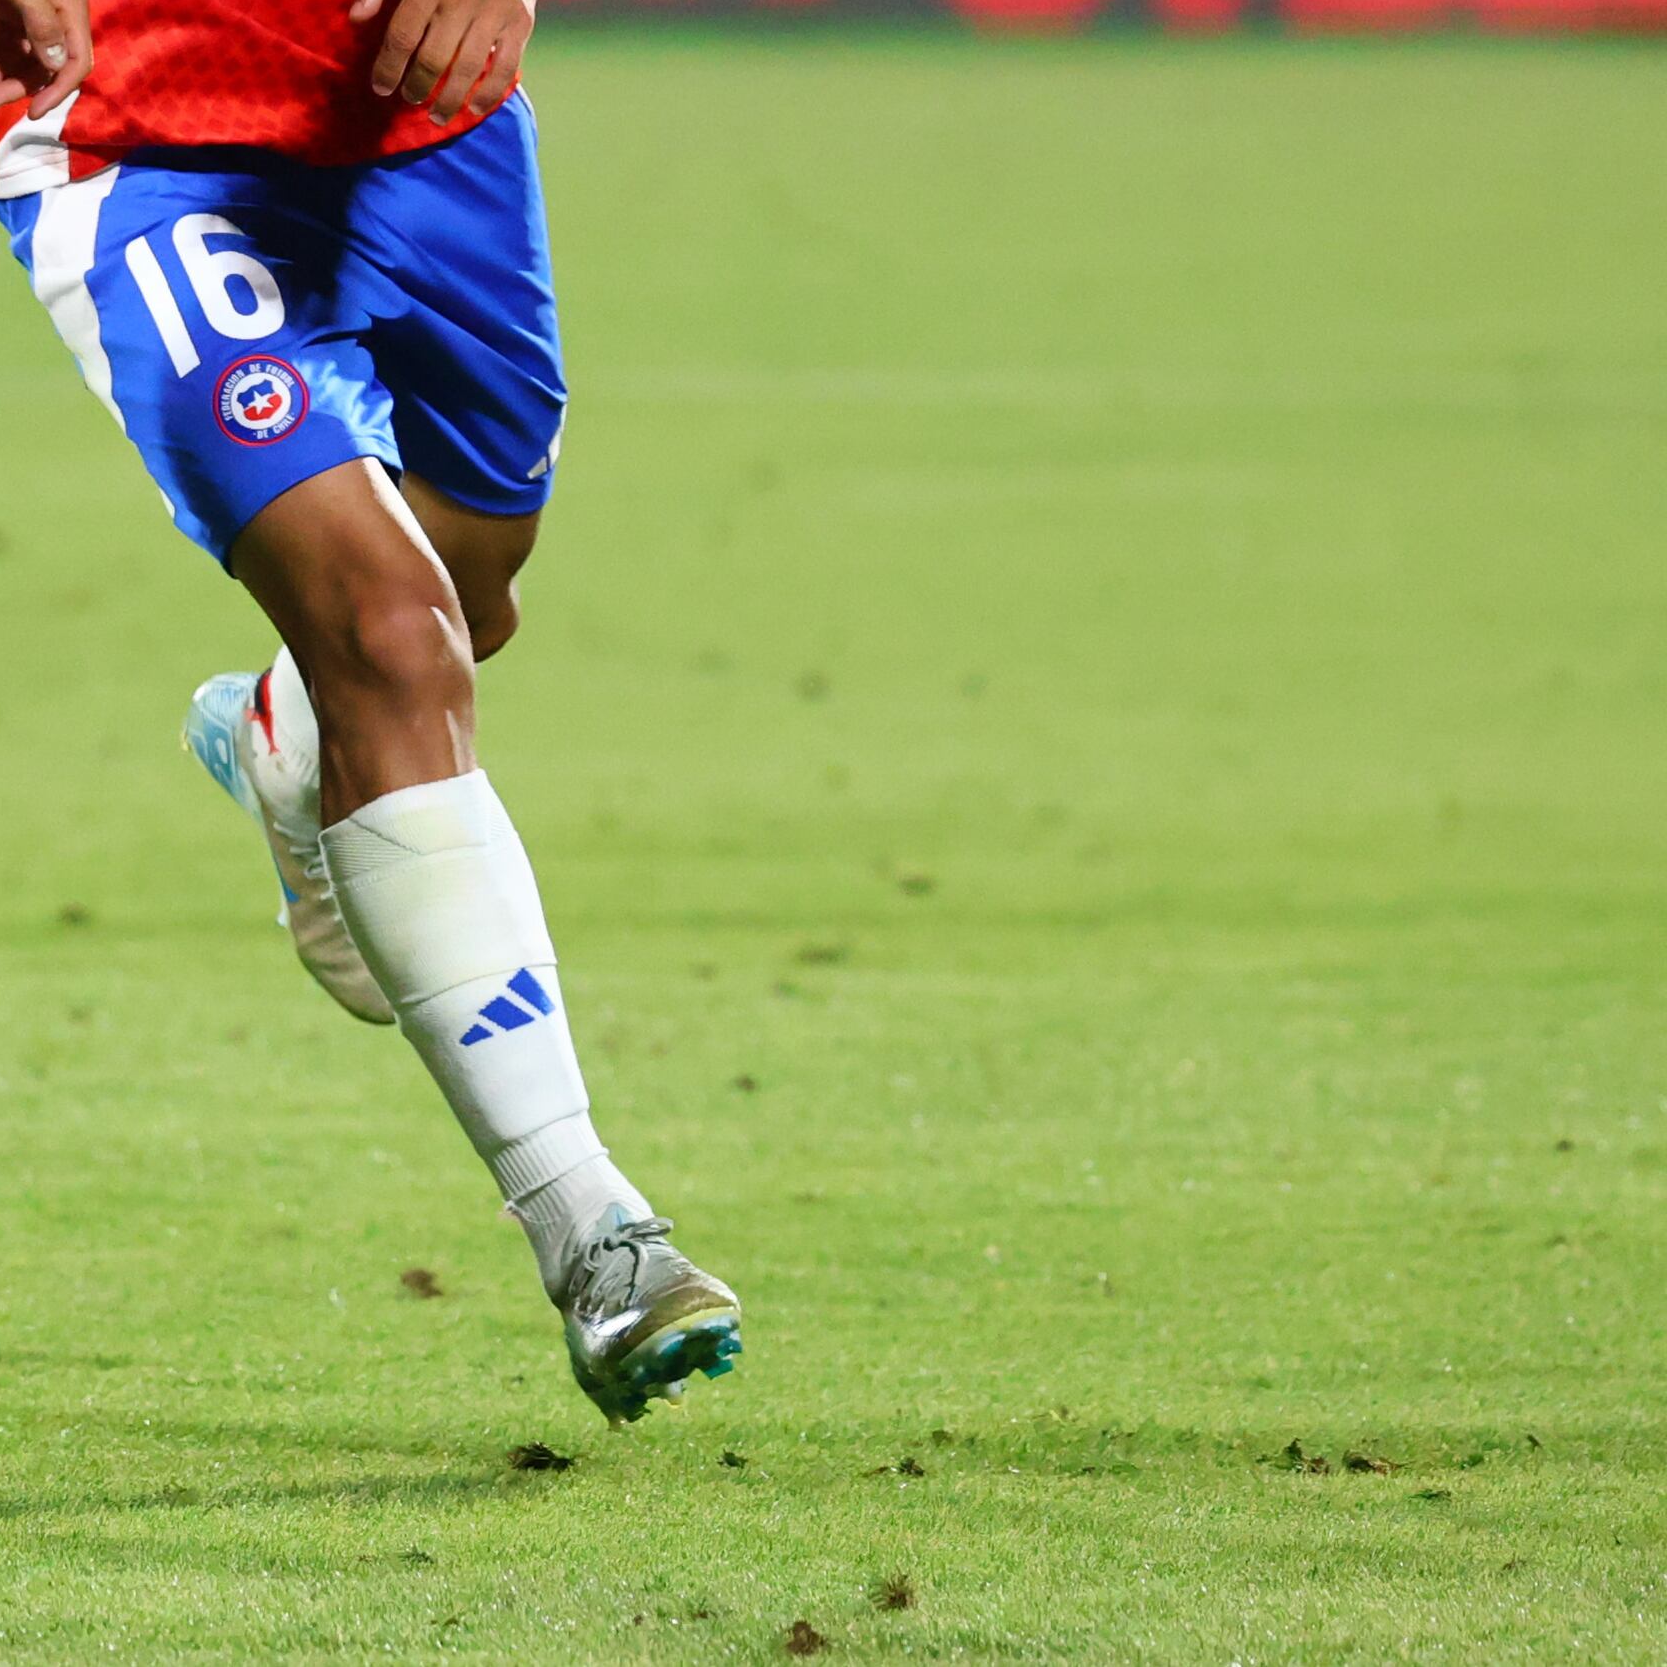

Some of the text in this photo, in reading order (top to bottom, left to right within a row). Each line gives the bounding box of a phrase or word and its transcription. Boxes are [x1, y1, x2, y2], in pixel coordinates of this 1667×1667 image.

[125, 213, 286, 379] 16
[249, 363, 262, 373] DE
[257, 429, 269, 440] DE
